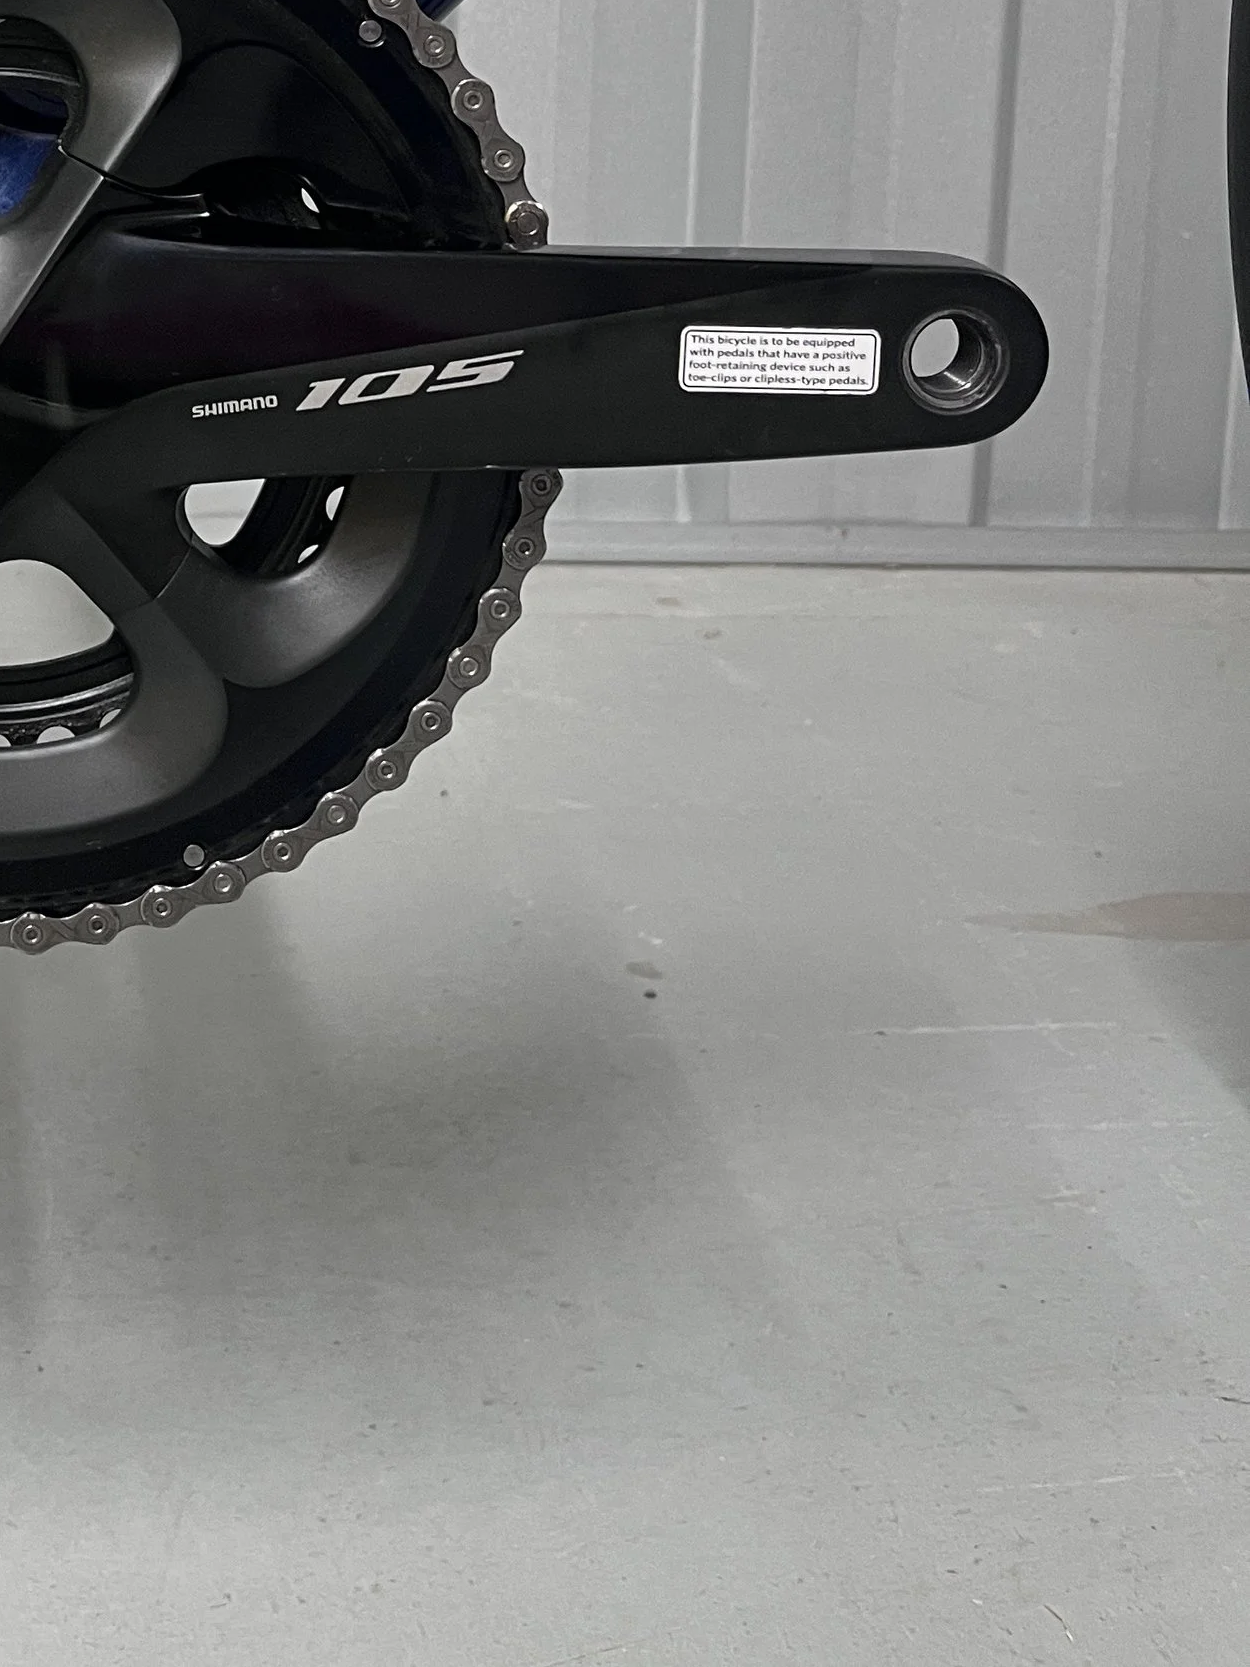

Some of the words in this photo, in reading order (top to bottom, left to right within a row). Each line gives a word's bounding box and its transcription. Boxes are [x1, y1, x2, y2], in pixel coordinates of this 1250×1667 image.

[690, 334, 715, 344] This
[717, 335, 757, 346] bicycle
[759, 336, 769, 346] is
[771, 337, 783, 346] to
[786, 337, 800, 346] be
[802, 338, 856, 349] equipped
[690, 348, 715, 357] with
[717, 348, 755, 359] pedals
[757, 349, 781, 359] that
[783, 349, 811, 359] have
[822, 350, 867, 361] positive
[689, 360, 768, 373] foot-retaining
[769, 361, 806, 372] device
[808, 363, 835, 373] such
[837, 365, 851, 373] as
[191, 394, 279, 419] SHIMANO
[295, 349, 525, 412] 105
[688, 373, 738, 384] toe-clips
[754, 374, 827, 386] clipless-type
[828, 376, 870, 387] pedals.
